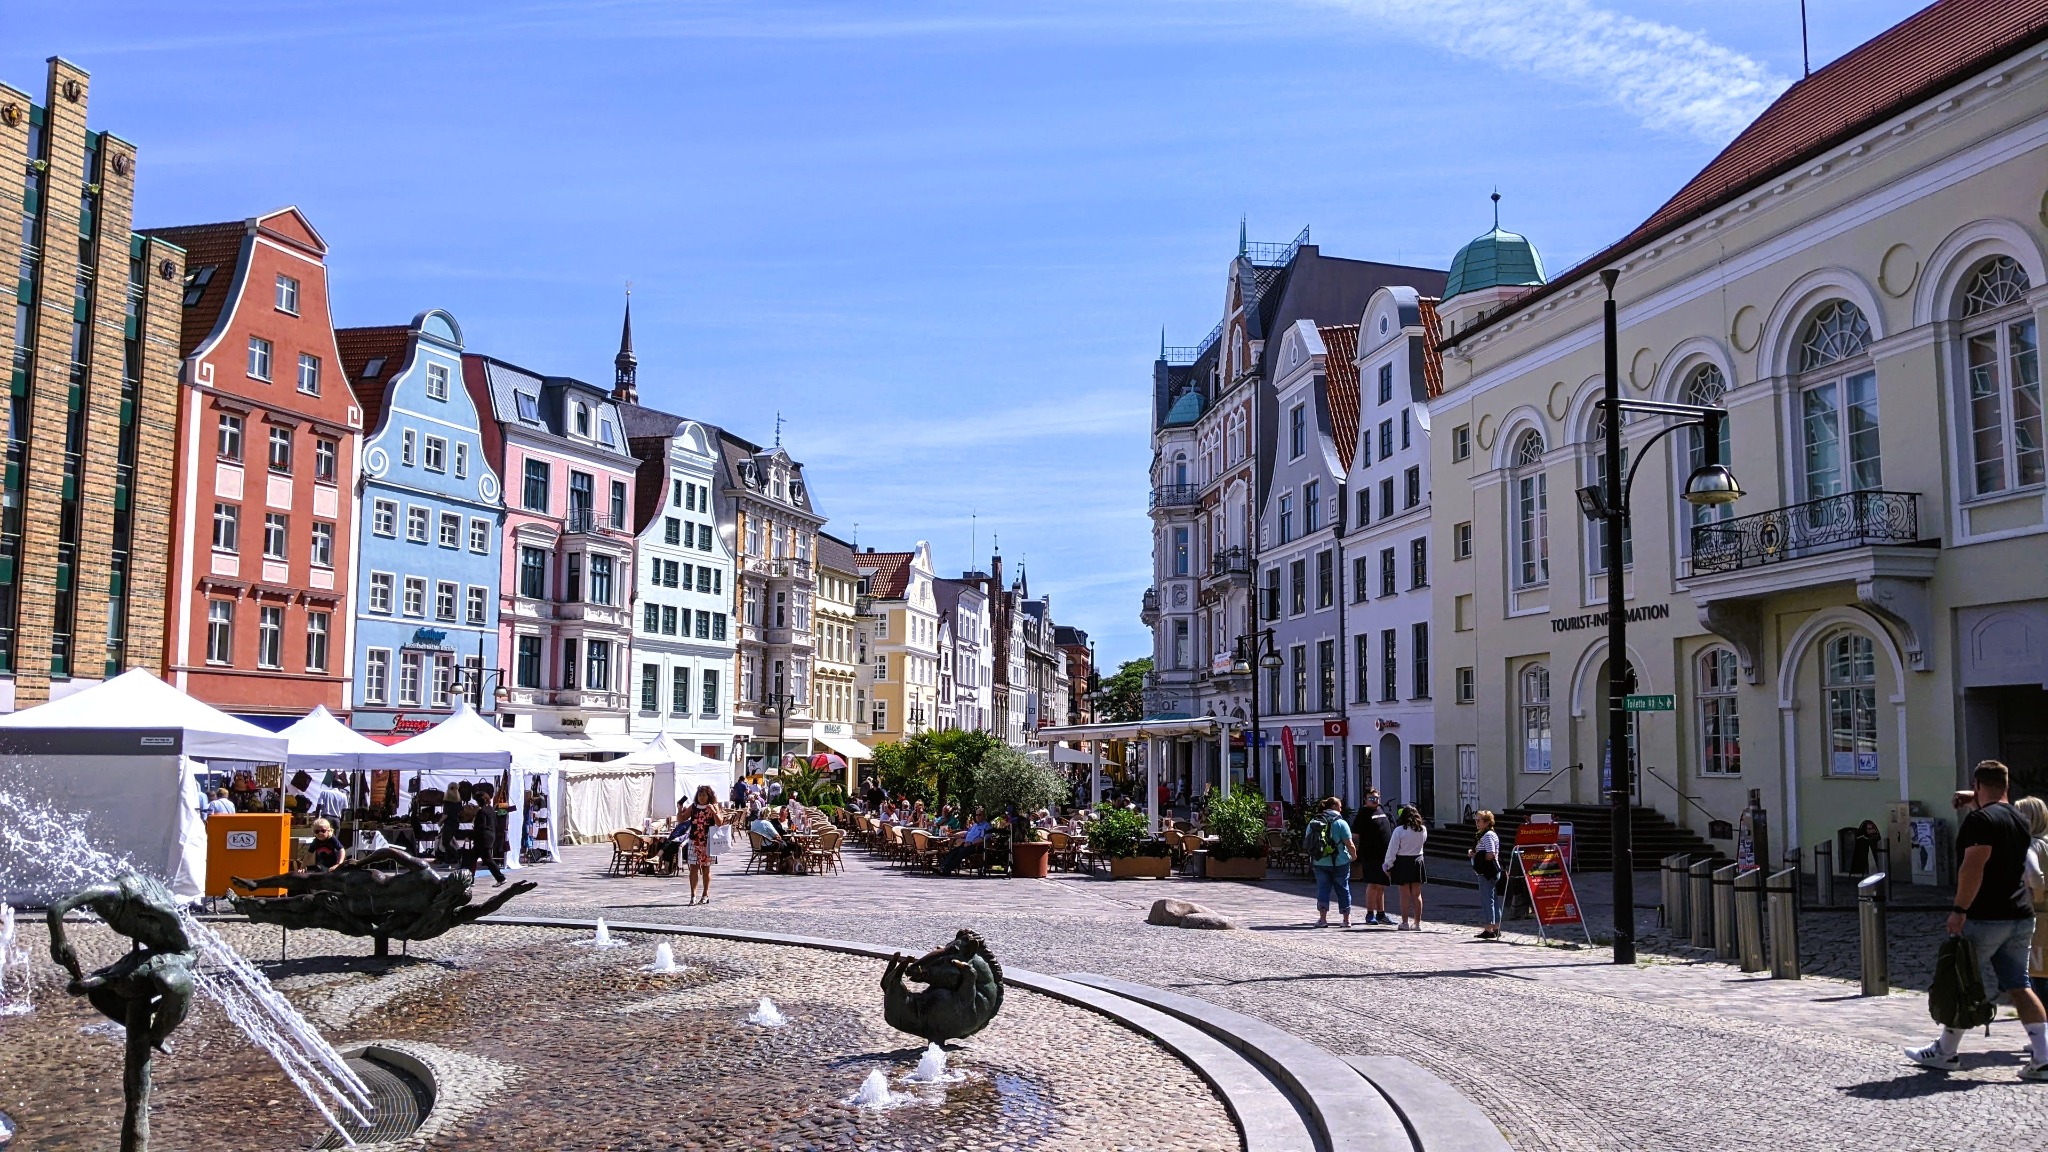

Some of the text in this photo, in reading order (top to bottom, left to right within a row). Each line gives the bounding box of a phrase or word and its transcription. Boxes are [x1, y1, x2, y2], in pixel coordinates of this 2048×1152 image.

[1551, 604, 1669, 632] TOURIST-INFMATION
[1627, 699, 1646, 709] Toilette
[562, 717, 584, 728] BONITA
[232, 835, 251, 845] EAS
